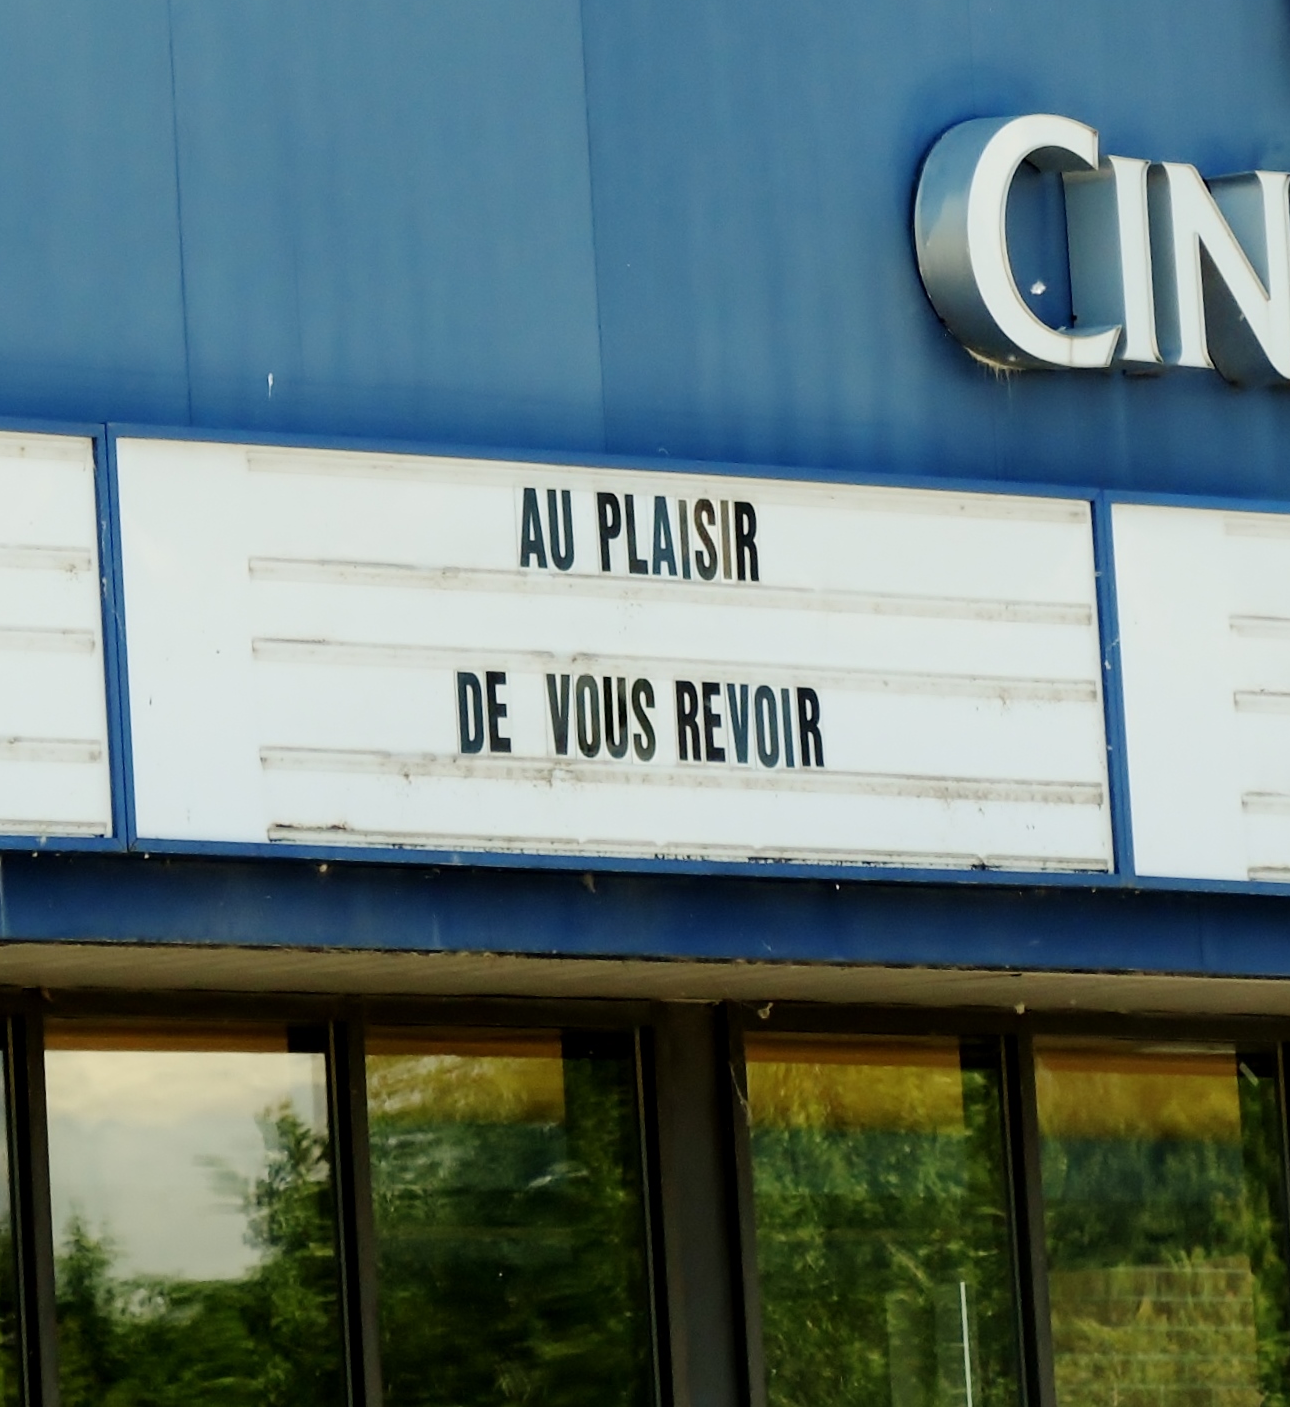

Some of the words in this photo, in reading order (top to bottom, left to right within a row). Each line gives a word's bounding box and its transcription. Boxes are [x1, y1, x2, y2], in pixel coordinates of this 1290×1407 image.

[520, 488, 574, 571] AU
[597, 492, 759, 581] PLAISIR
[457, 671, 511, 754] DE
[546, 674, 655, 761] VOUS
[675, 680, 824, 768] REVOIR
